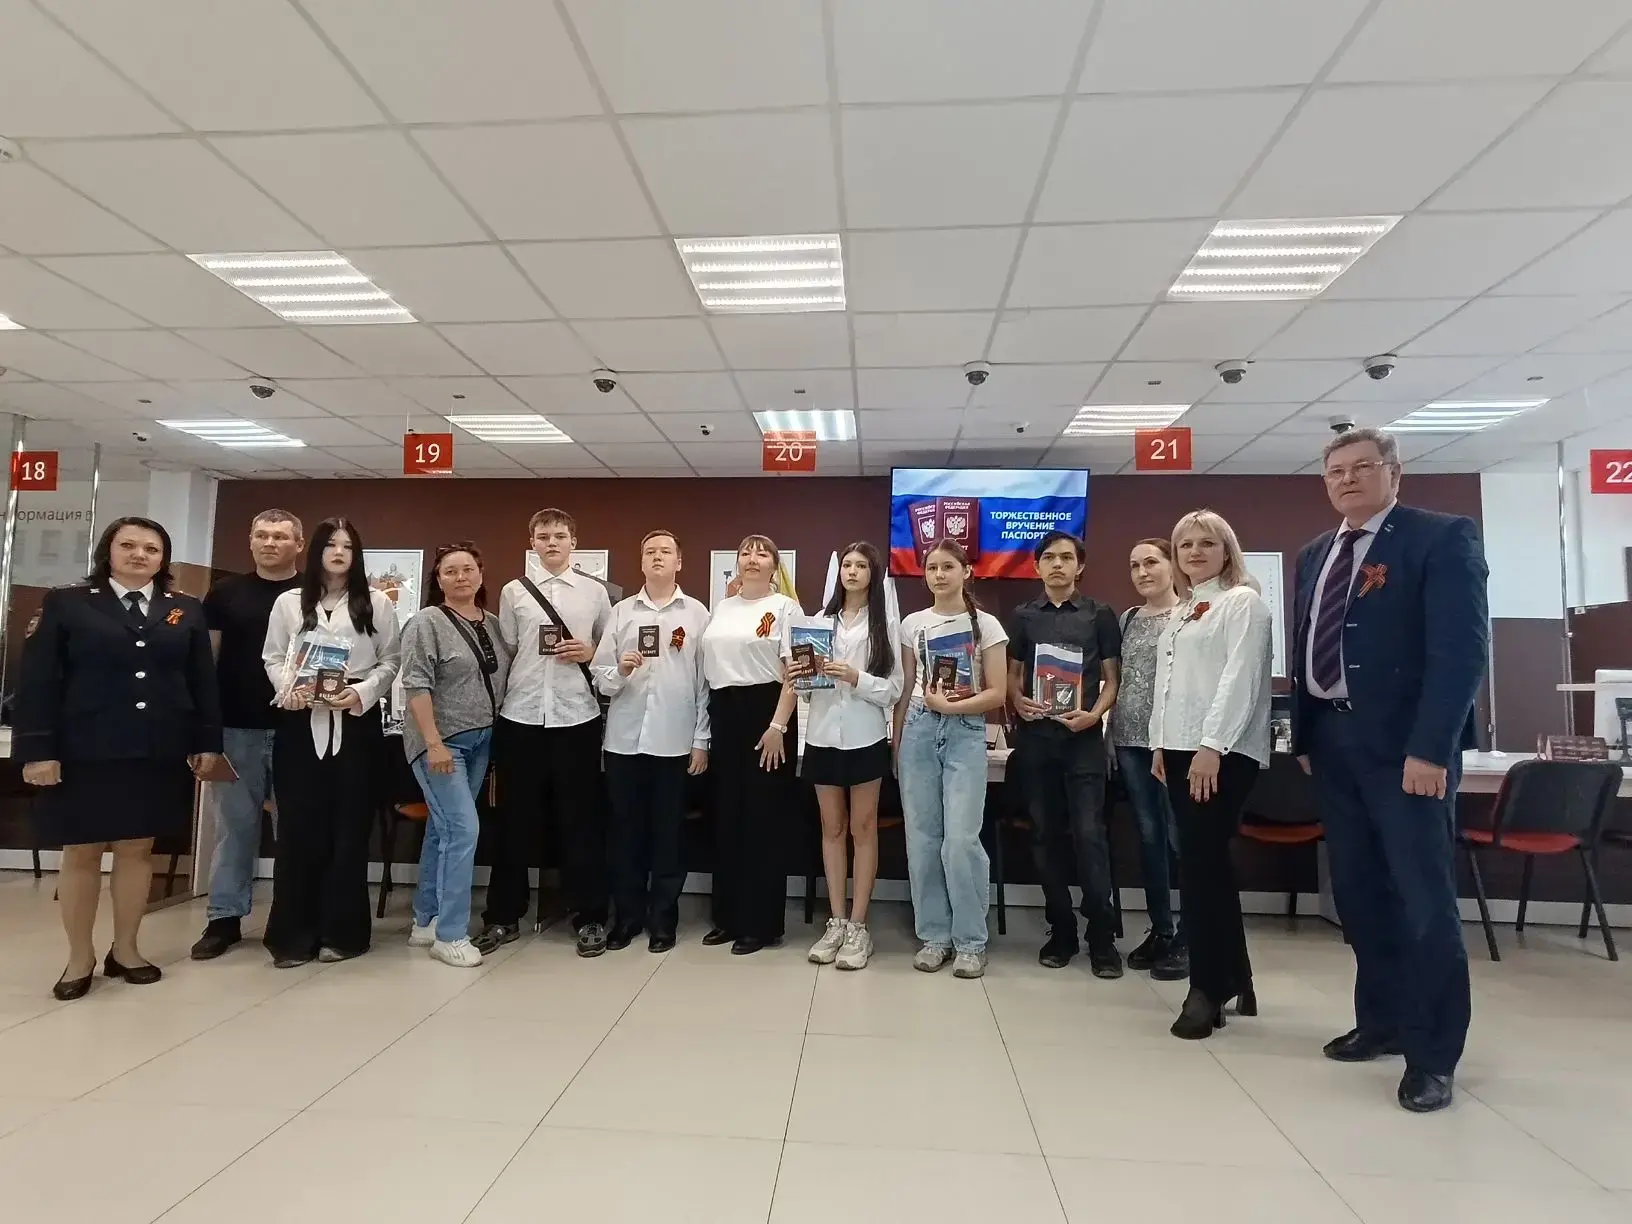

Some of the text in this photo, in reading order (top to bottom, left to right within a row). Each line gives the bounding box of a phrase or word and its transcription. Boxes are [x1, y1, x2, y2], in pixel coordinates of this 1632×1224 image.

[415, 443, 440, 463] 19
[775, 441, 803, 462] 20
[1150, 438, 1177, 460] 21
[21, 461, 46, 481] 18
[990, 511, 1072, 521] ТОРЖЕСТВЕННОЕ
[1005, 521, 1055, 531] ВРУЧЕНИЕ
[1001, 531, 1049, 540] ПАСПОРТ
